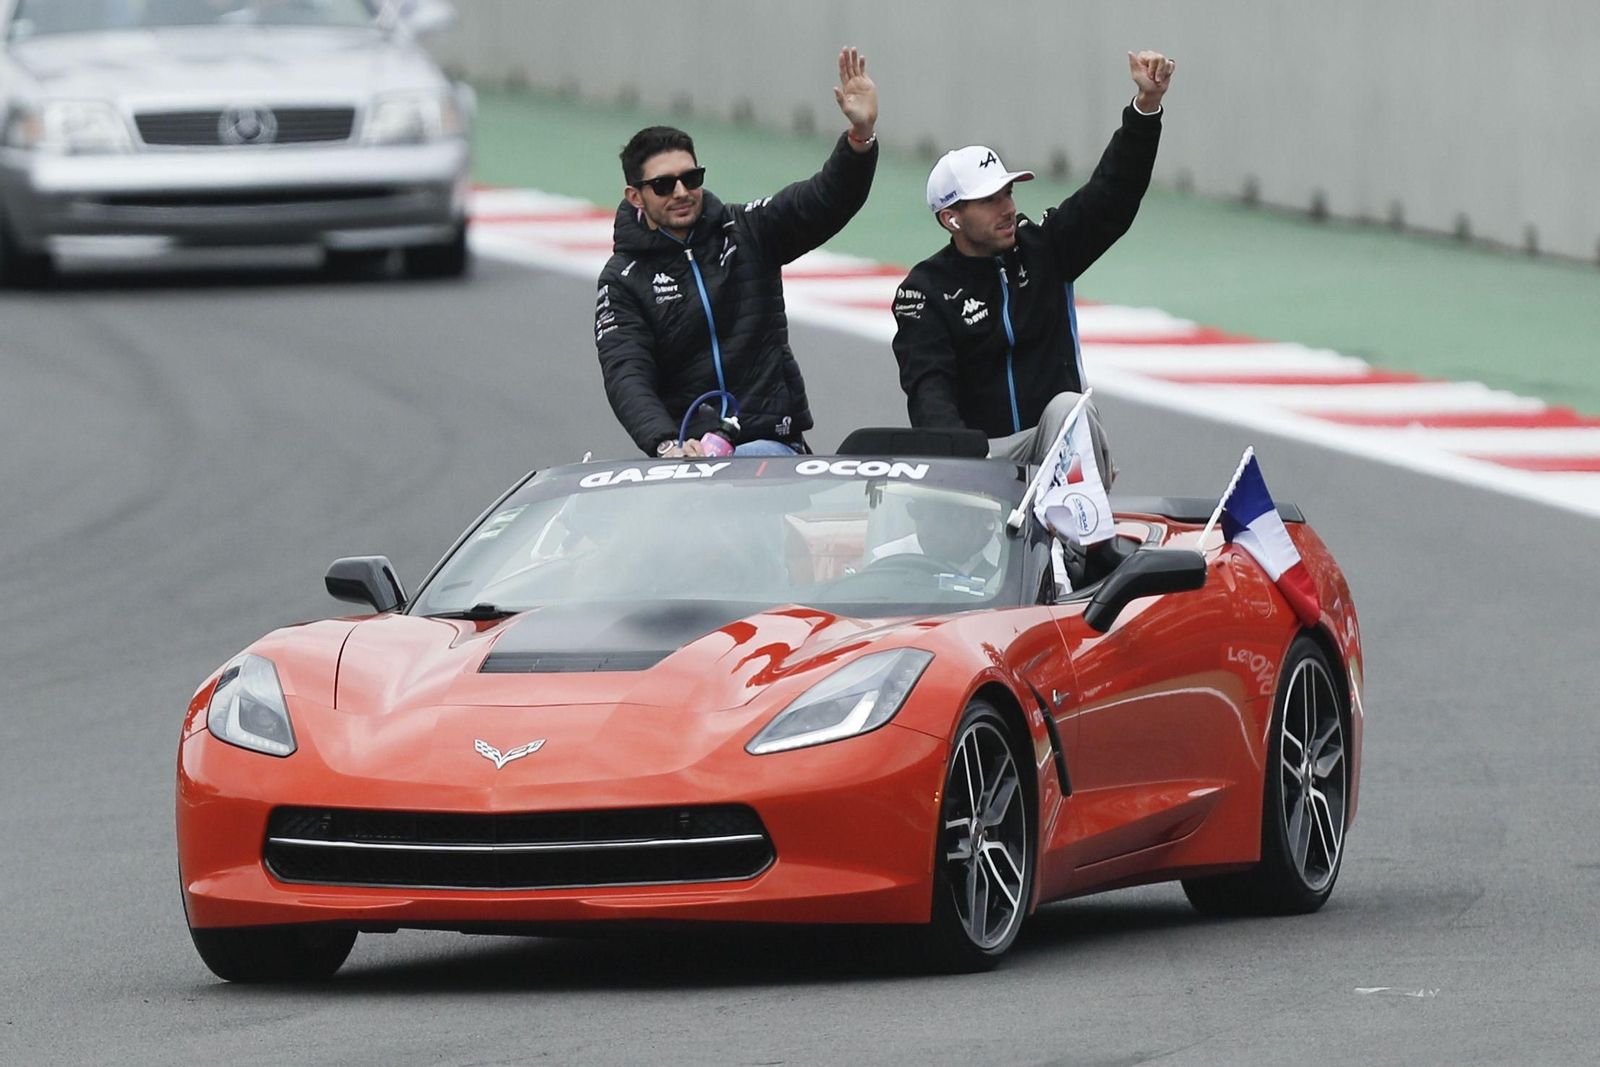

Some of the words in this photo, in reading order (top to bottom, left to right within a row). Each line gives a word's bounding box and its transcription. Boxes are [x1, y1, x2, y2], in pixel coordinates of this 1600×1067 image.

[971, 307, 989, 323] BWT
[579, 462, 731, 488] GASLY
[795, 460, 930, 480] OCON
